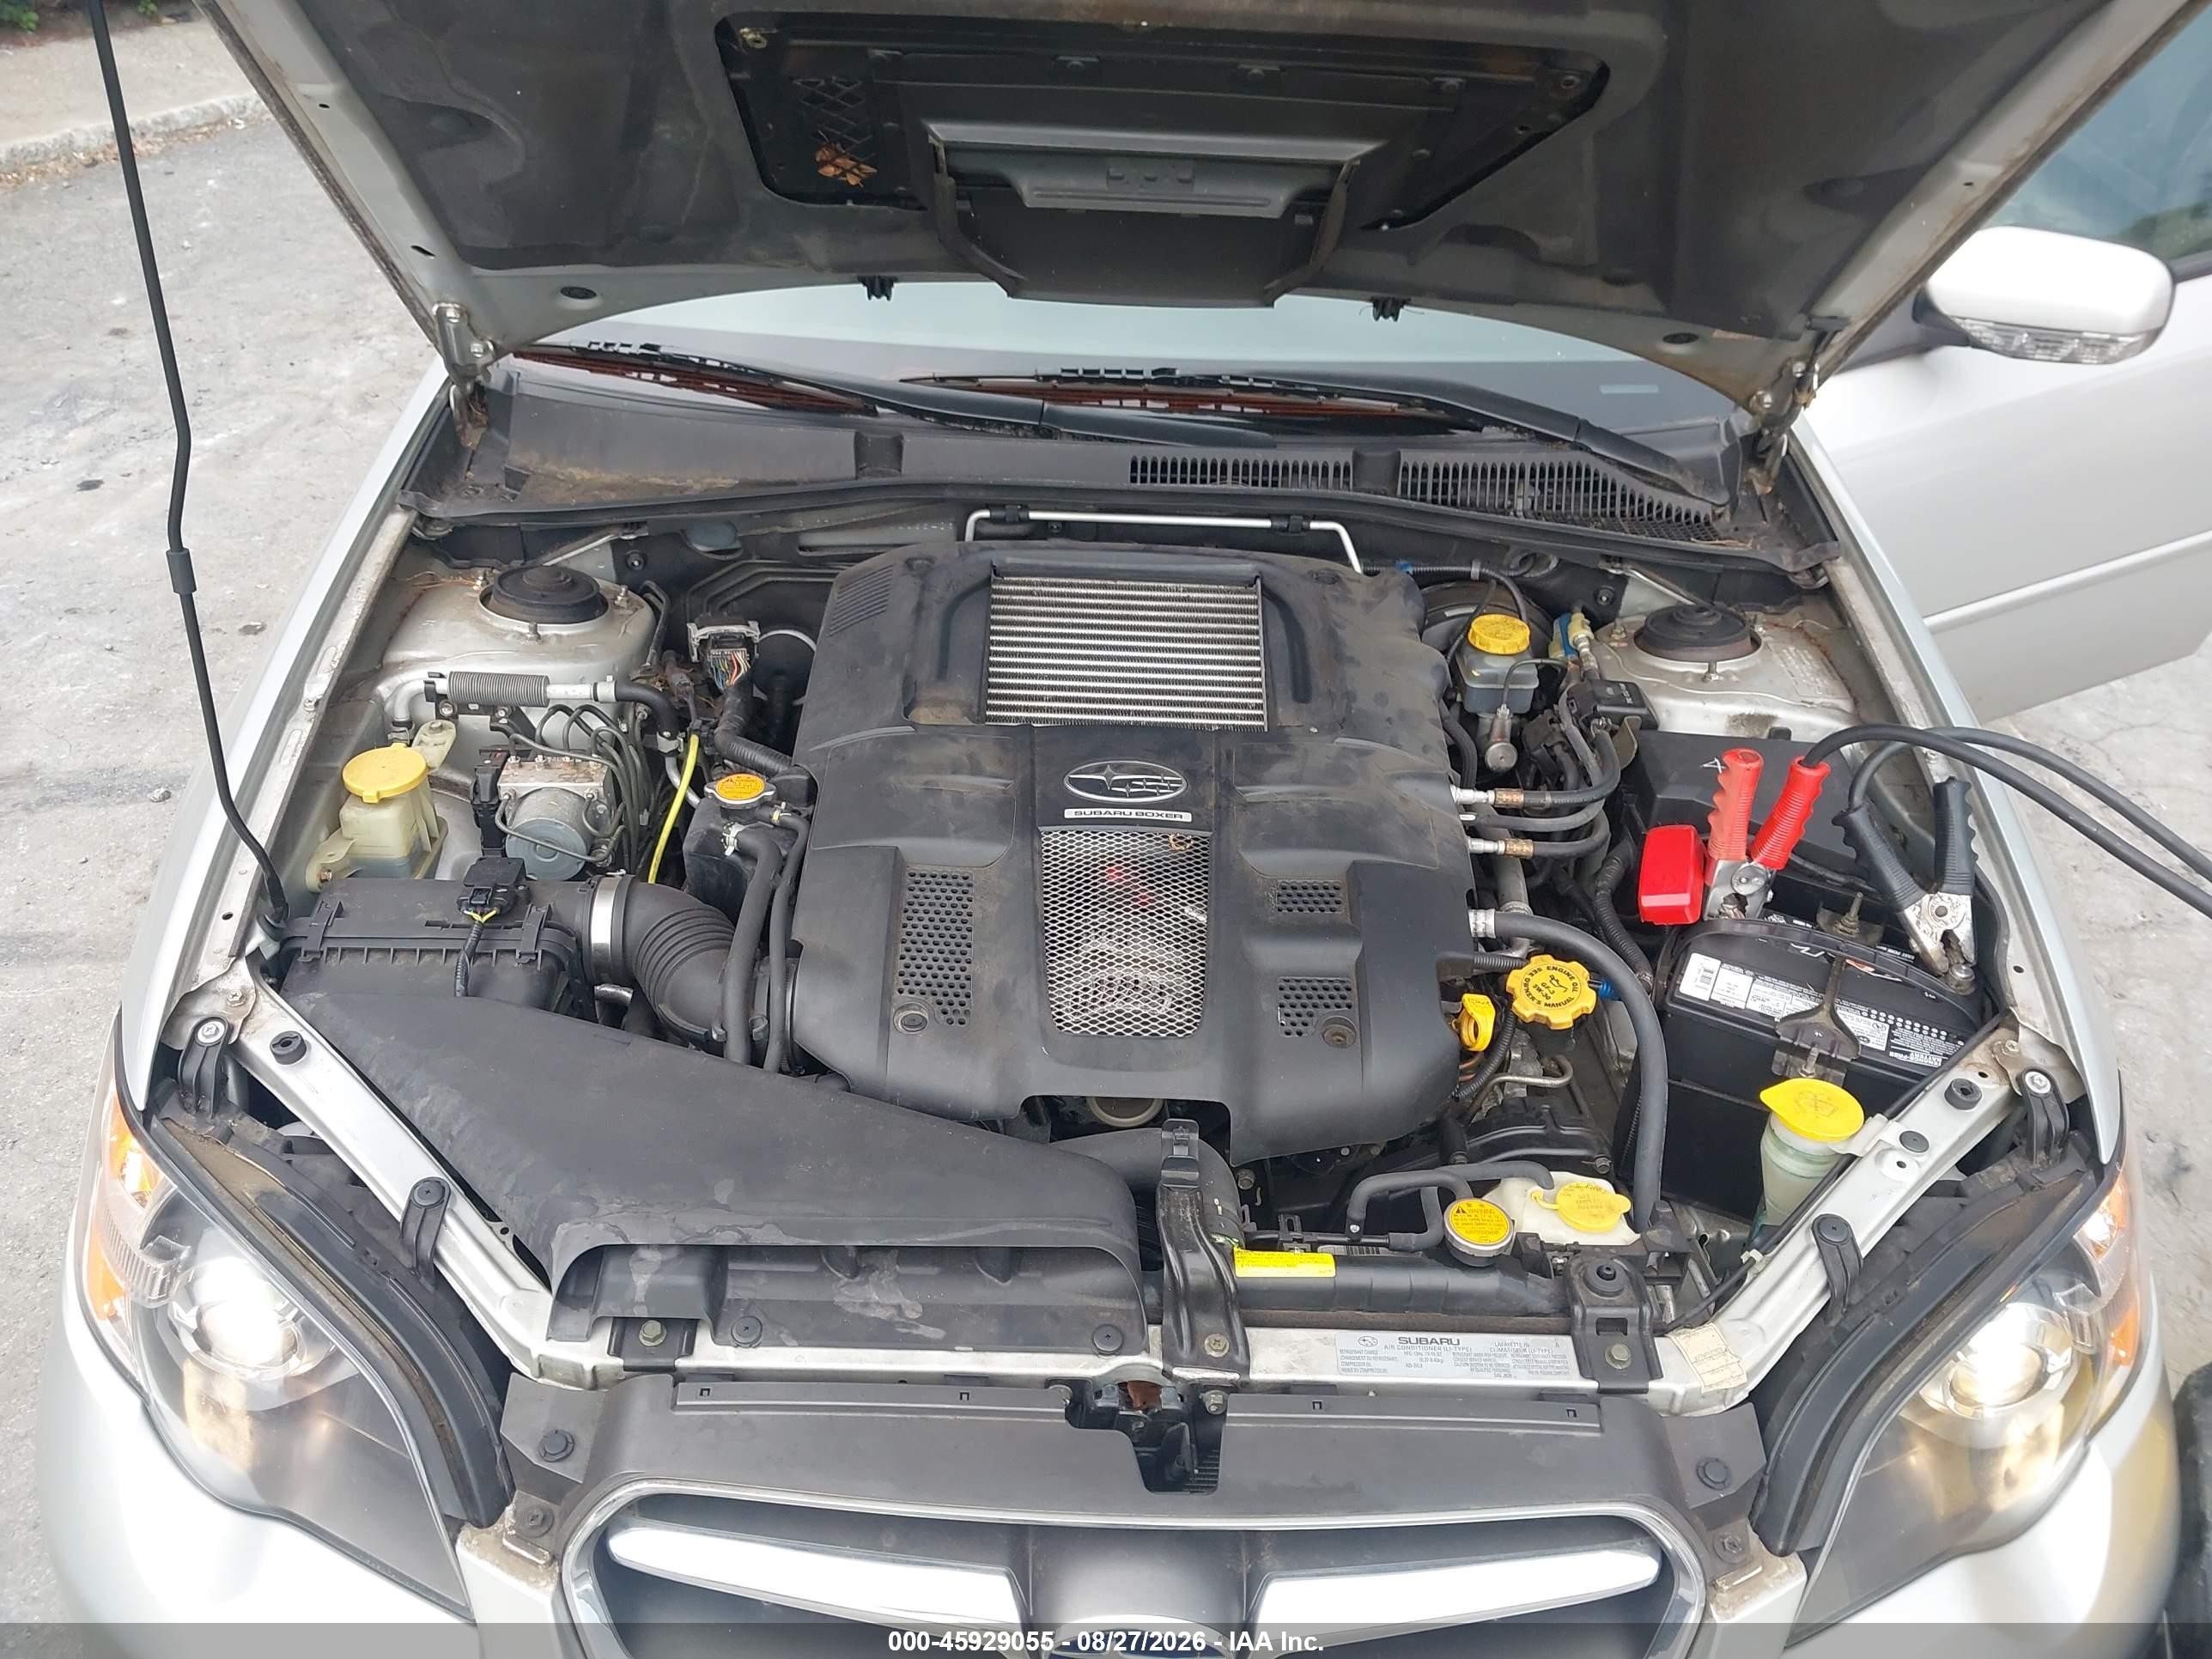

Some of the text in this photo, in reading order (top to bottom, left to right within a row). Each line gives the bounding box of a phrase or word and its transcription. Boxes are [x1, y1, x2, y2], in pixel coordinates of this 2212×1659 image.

[1135, 811, 1183, 819] BOXER
[1546, 965, 1576, 981] ENGINE
[1528, 967, 1543, 977] SEE
[1544, 996, 1575, 1008] MANUAL
[1398, 1336, 1460, 1346] SUBARU
